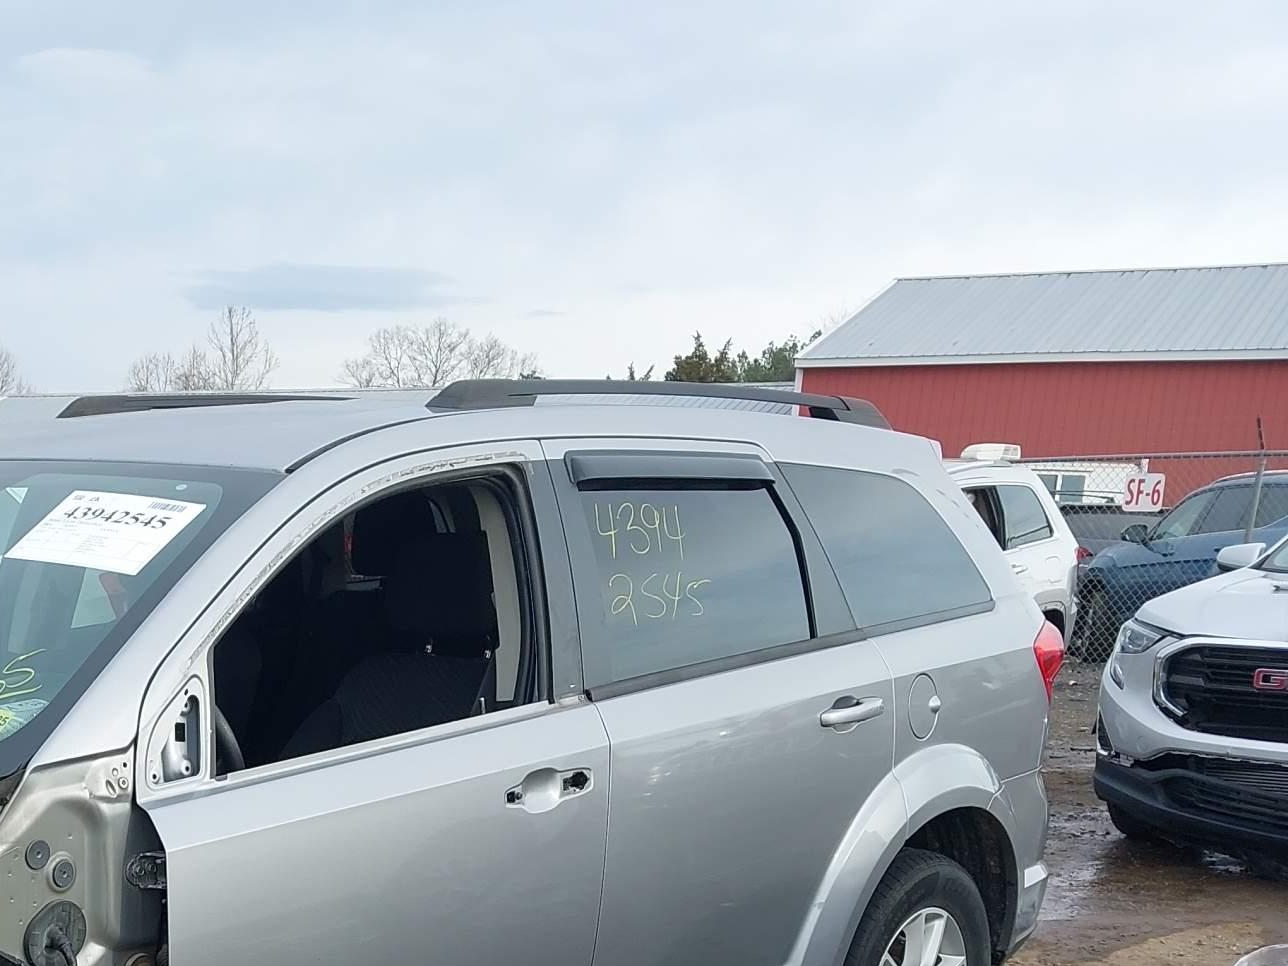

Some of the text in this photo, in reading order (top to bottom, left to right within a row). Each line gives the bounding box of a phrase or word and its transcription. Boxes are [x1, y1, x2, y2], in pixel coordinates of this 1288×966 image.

[1125, 478, 1162, 506] SF-6
[64, 506, 172, 529] 43942545
[594, 502, 686, 560] 4394
[608, 571, 712, 627] 2545
